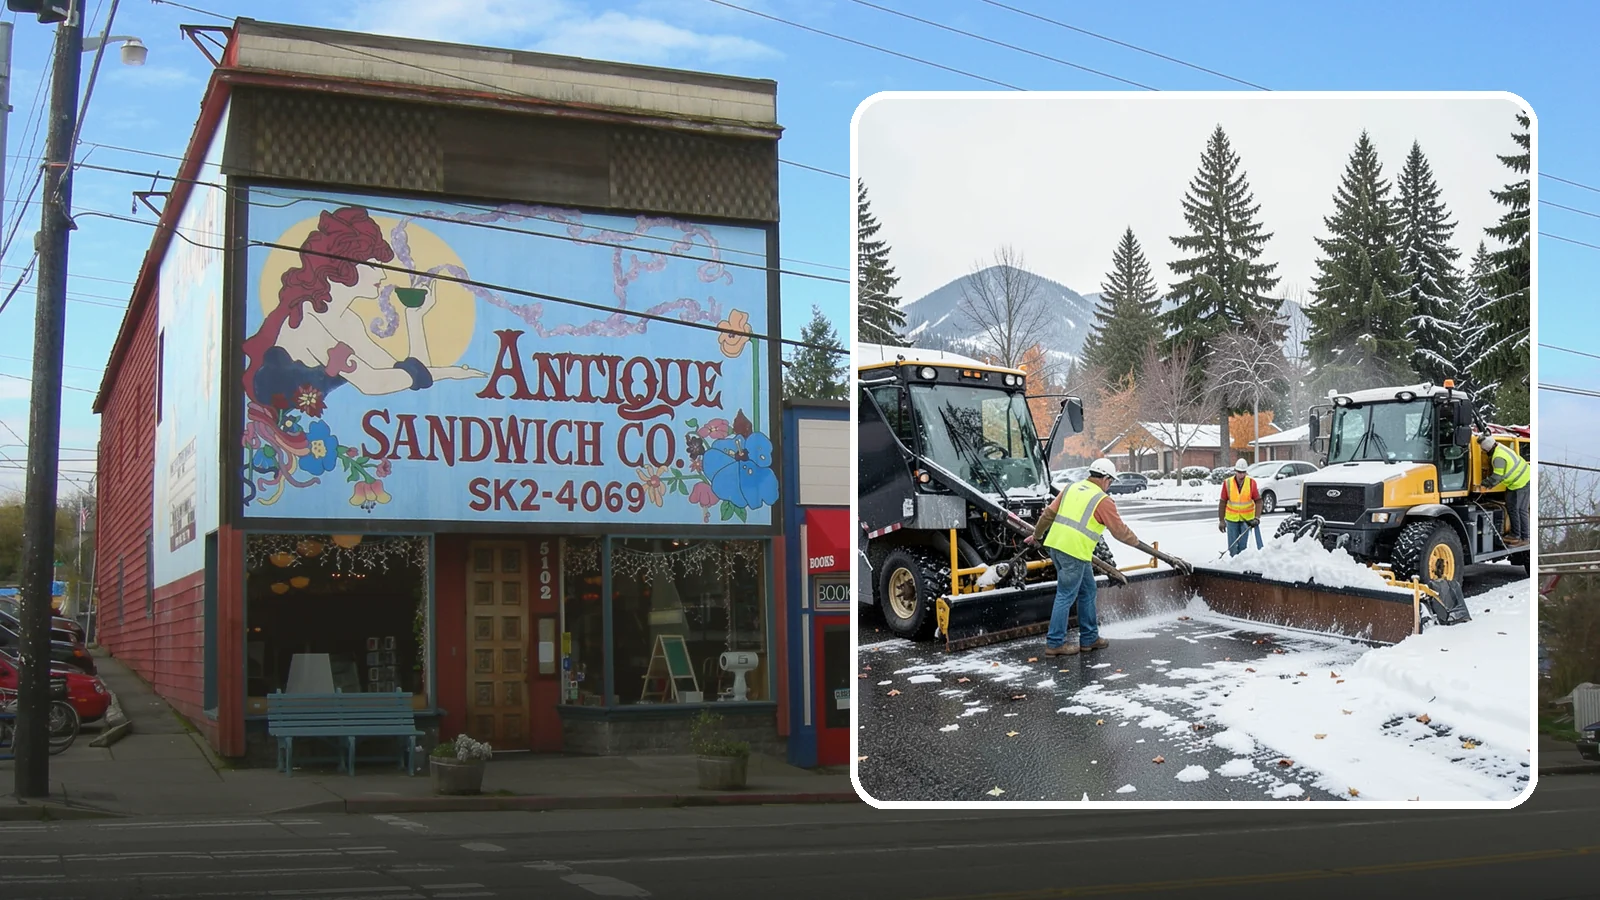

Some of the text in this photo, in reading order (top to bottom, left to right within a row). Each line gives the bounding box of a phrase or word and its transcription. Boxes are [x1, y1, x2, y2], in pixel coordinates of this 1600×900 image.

[475, 328, 723, 421] ANTIQUE
[361, 408, 686, 469] SANDWICH CO.
[468, 476, 646, 514] SK2-4069
[540, 542, 551, 599] 5102
[809, 554, 835, 569] BOOKS
